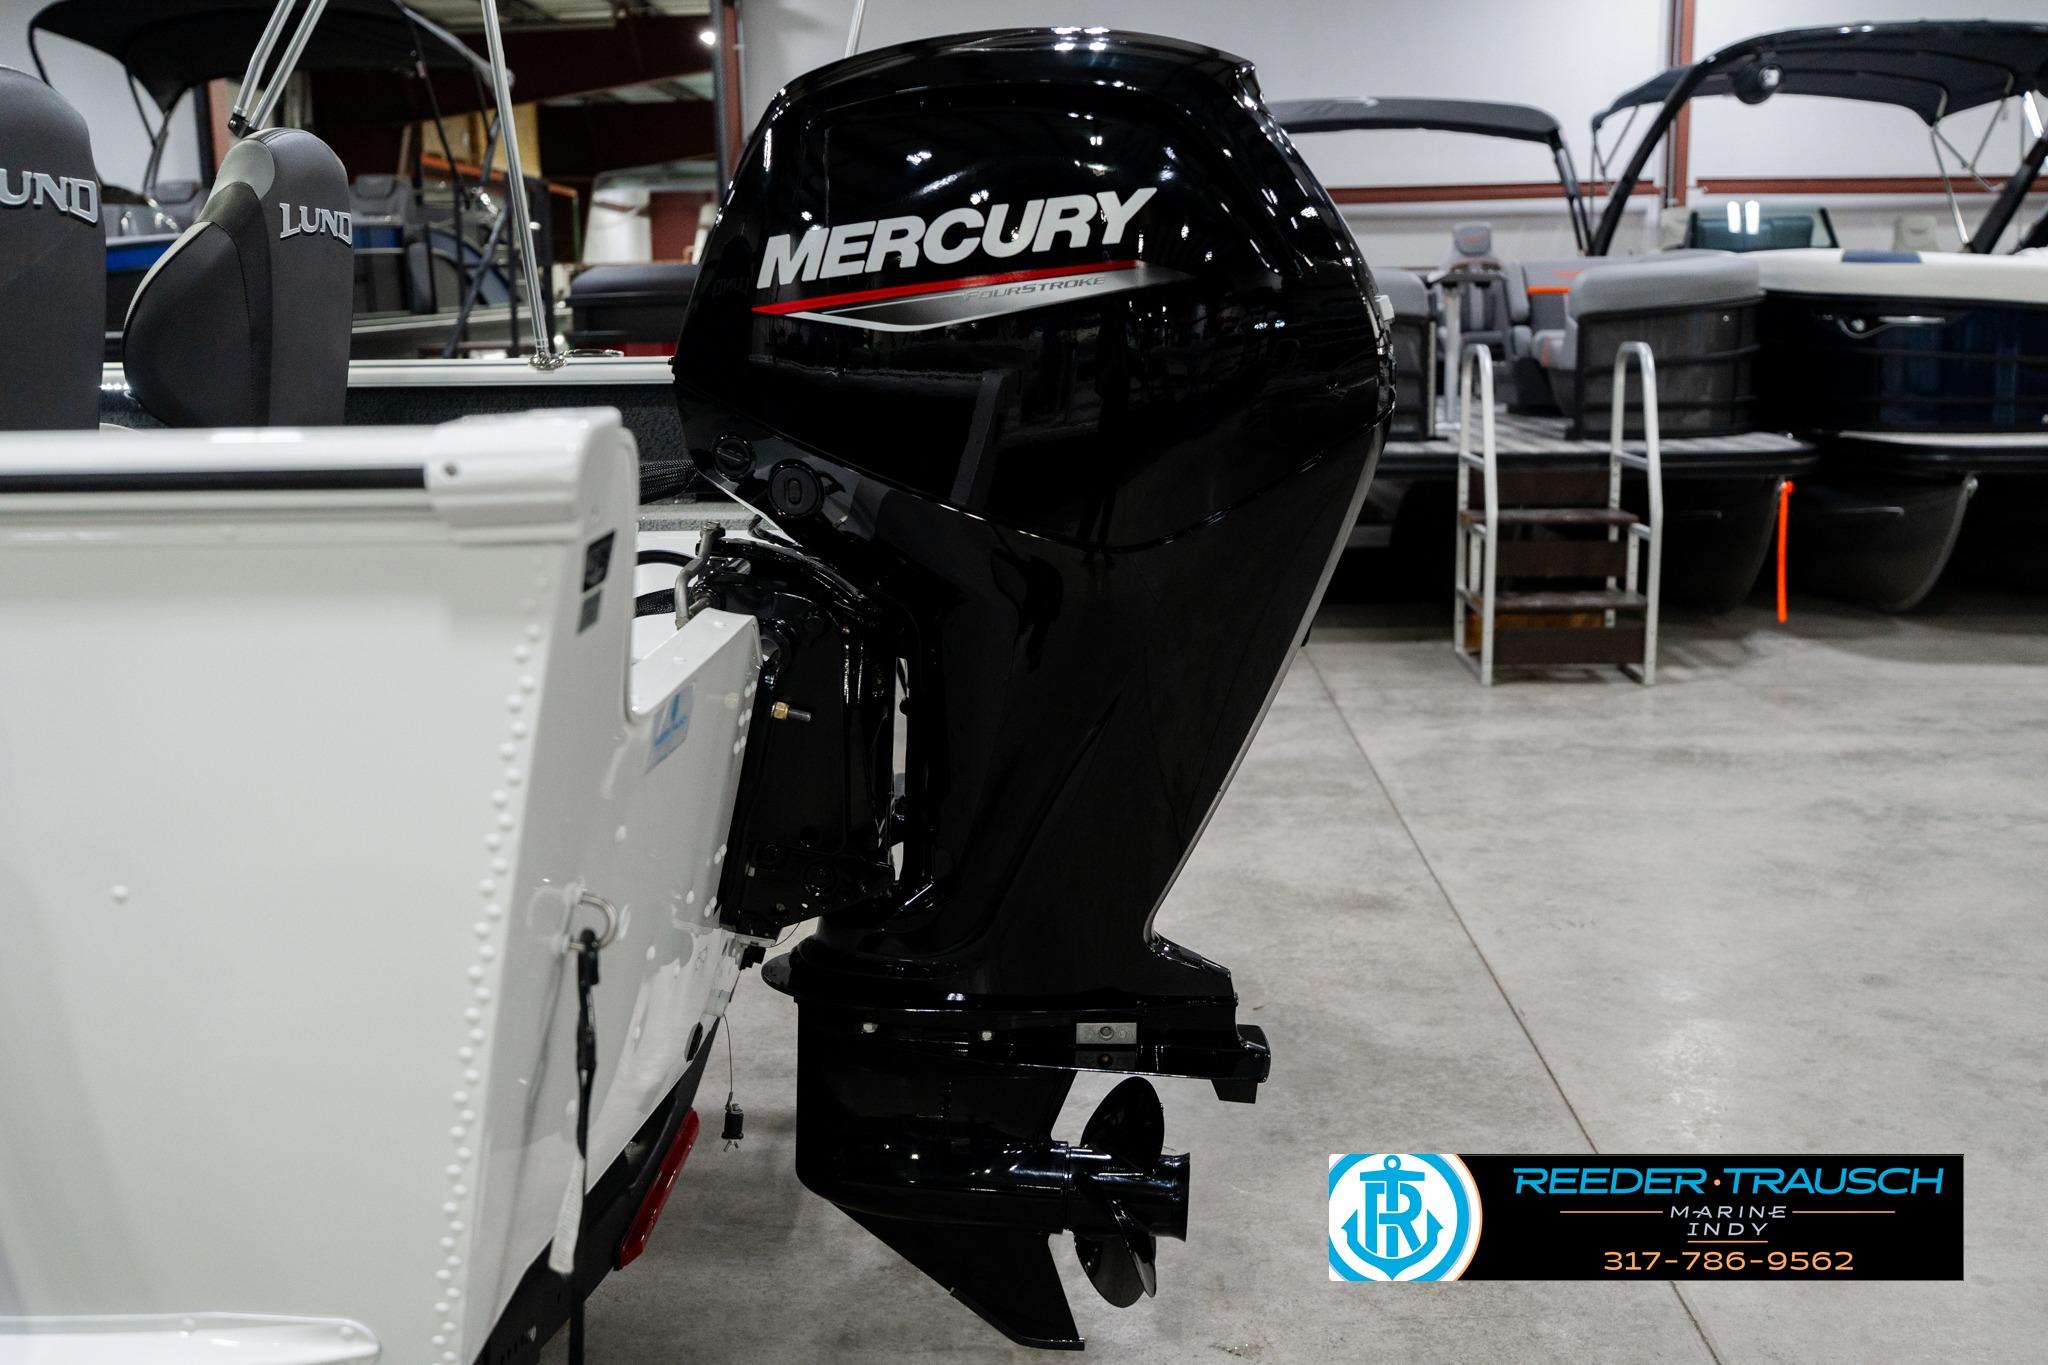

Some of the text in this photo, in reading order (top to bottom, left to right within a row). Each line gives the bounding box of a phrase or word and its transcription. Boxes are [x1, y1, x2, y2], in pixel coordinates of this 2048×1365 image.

[0, 167, 98, 223] UND
[279, 202, 353, 245] LUND
[756, 187, 1158, 290] MERCURY
[965, 276, 1105, 301] FOURSTROKE
